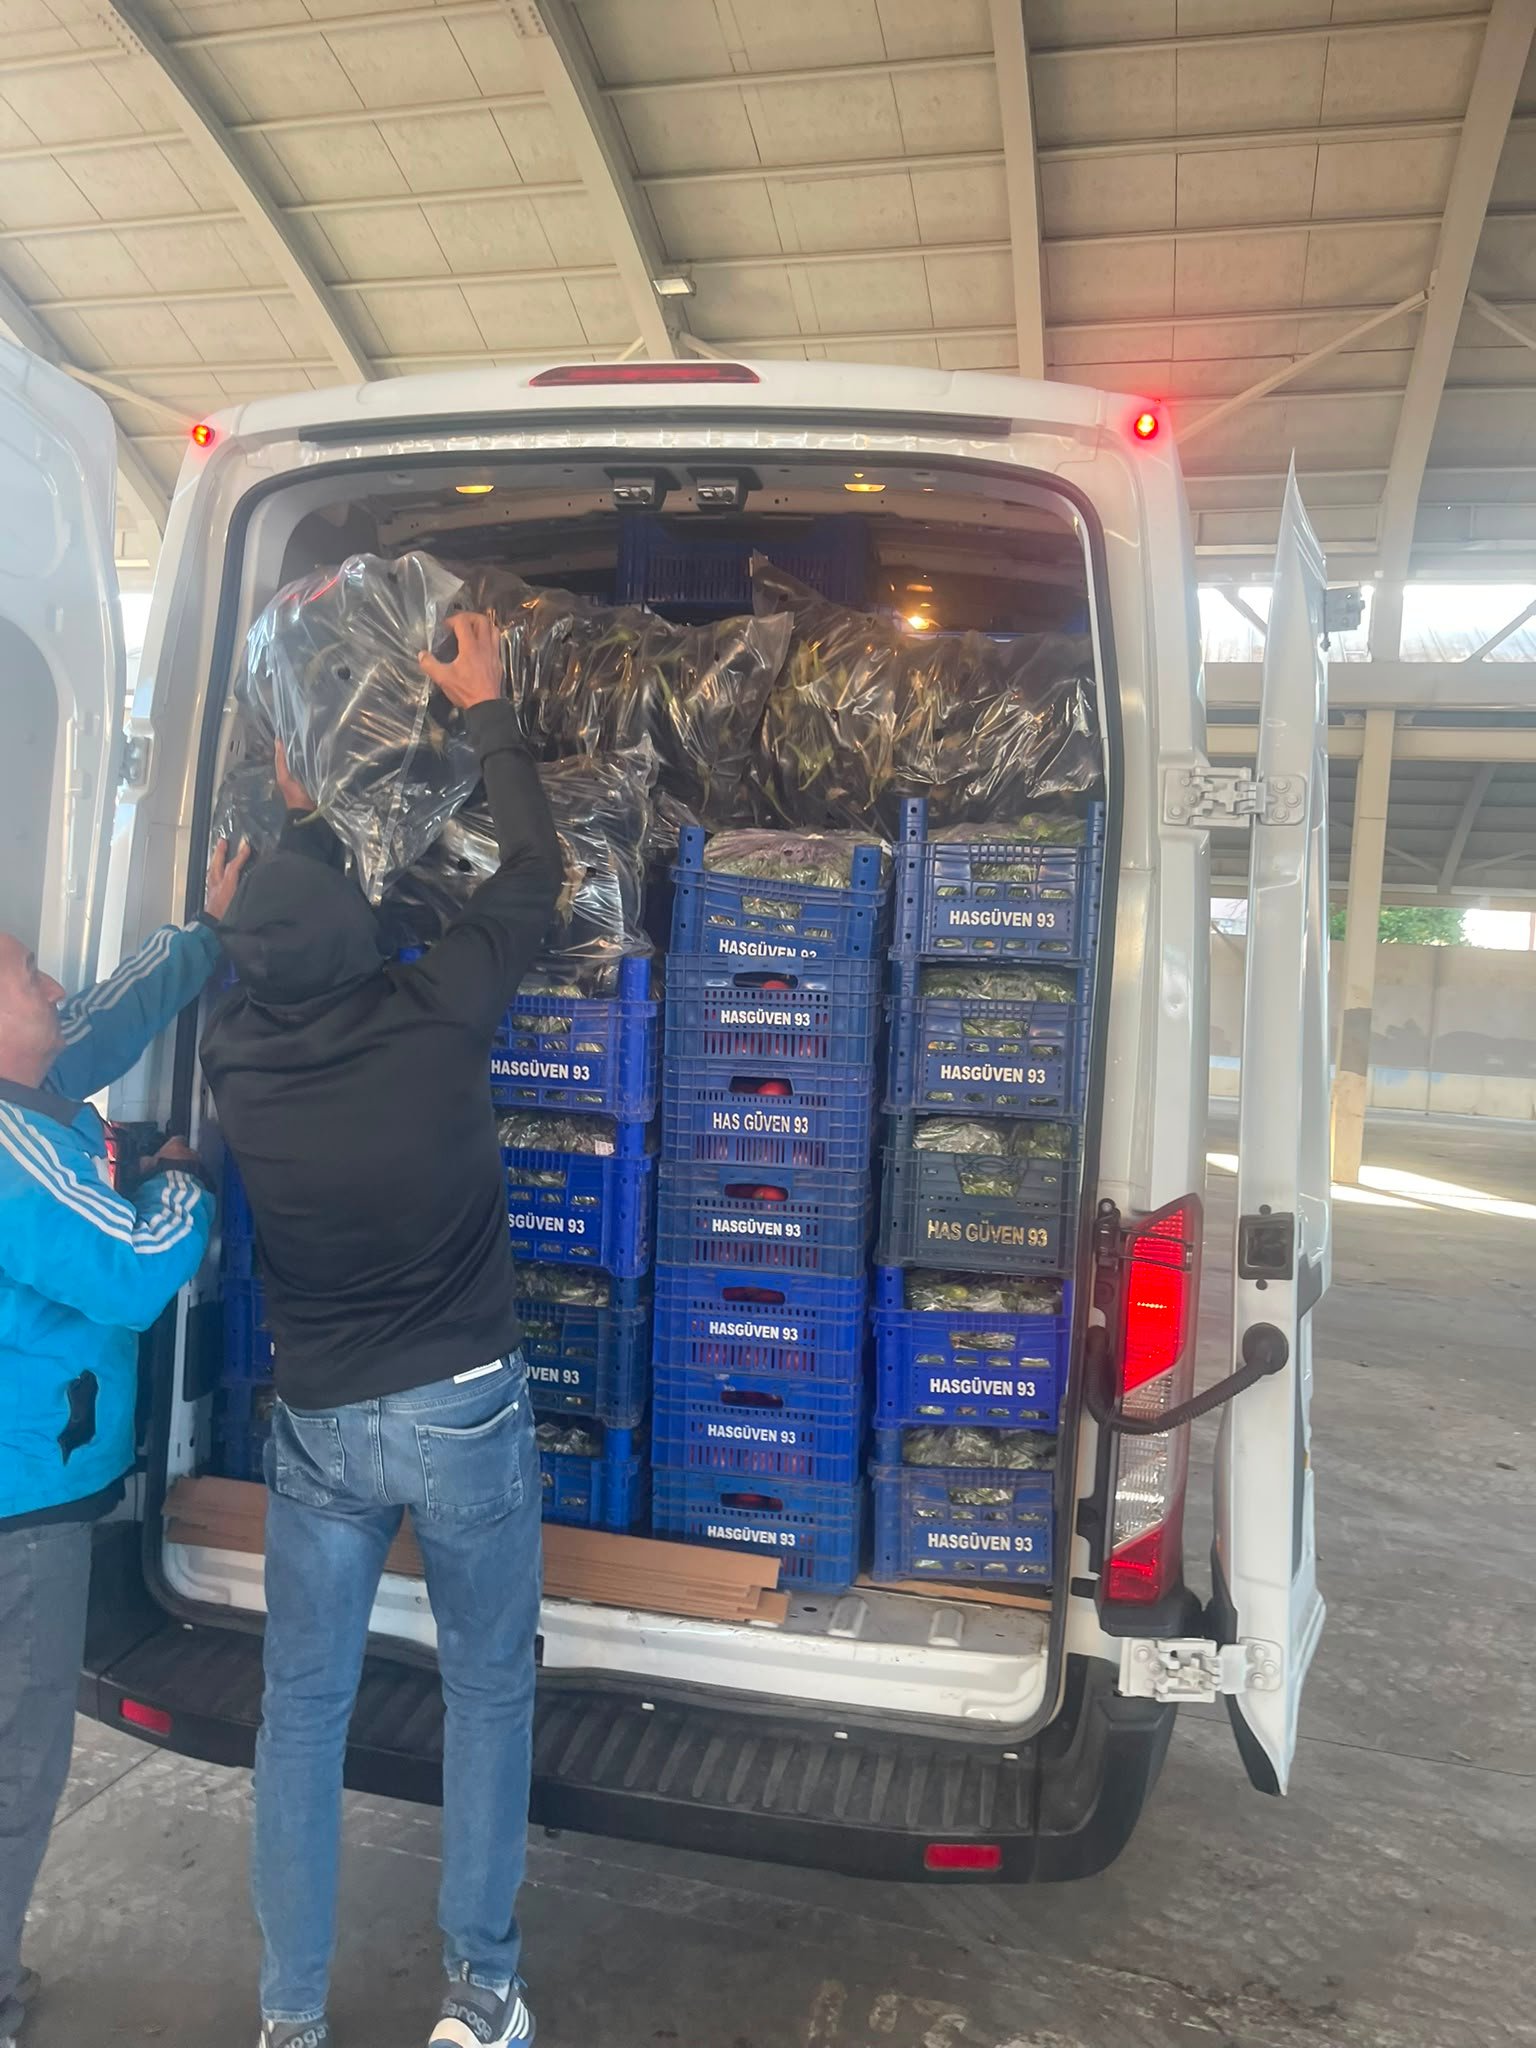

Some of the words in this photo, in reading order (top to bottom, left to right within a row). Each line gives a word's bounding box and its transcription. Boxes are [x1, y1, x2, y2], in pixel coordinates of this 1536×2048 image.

[949, 908, 1032, 928] HASGÜVEN
[1037, 912, 1056, 928] 93
[720, 1007, 792, 1026] HASGÜVEN
[794, 1012, 811, 1027] 93
[491, 1059, 569, 1080] HASGÜVEN
[572, 1063, 591, 1081] 93
[940, 1062, 1023, 1083] HASGÜVEN
[1027, 1068, 1046, 1085] 93
[712, 1111, 741, 1131] HAS
[744, 1110, 792, 1134] GÜVEN
[794, 1116, 809, 1135] 93
[508, 1211, 564, 1233] SGÜVEN
[567, 1218, 585, 1235] 93
[712, 1218, 783, 1237] HASGÜVEN
[785, 1223, 801, 1238] 93
[927, 1219, 962, 1241] HAS
[965, 1219, 1024, 1246] GÜVEN
[1027, 1227, 1049, 1248] 93
[709, 1320, 780, 1340] HASGÜVEN
[782, 1325, 798, 1341] 93
[562, 1369, 580, 1385] 93
[930, 1376, 1014, 1397] HASGÜVEN
[1017, 1380, 1036, 1397] 93
[707, 1423, 778, 1443] HASGÜVEN
[780, 1428, 796, 1444] 93
[707, 1524, 778, 1546] HASGÜVEN
[780, 1531, 796, 1547] 93
[927, 1531, 1011, 1552] HASGÜVEN
[1014, 1536, 1033, 1552] 93
